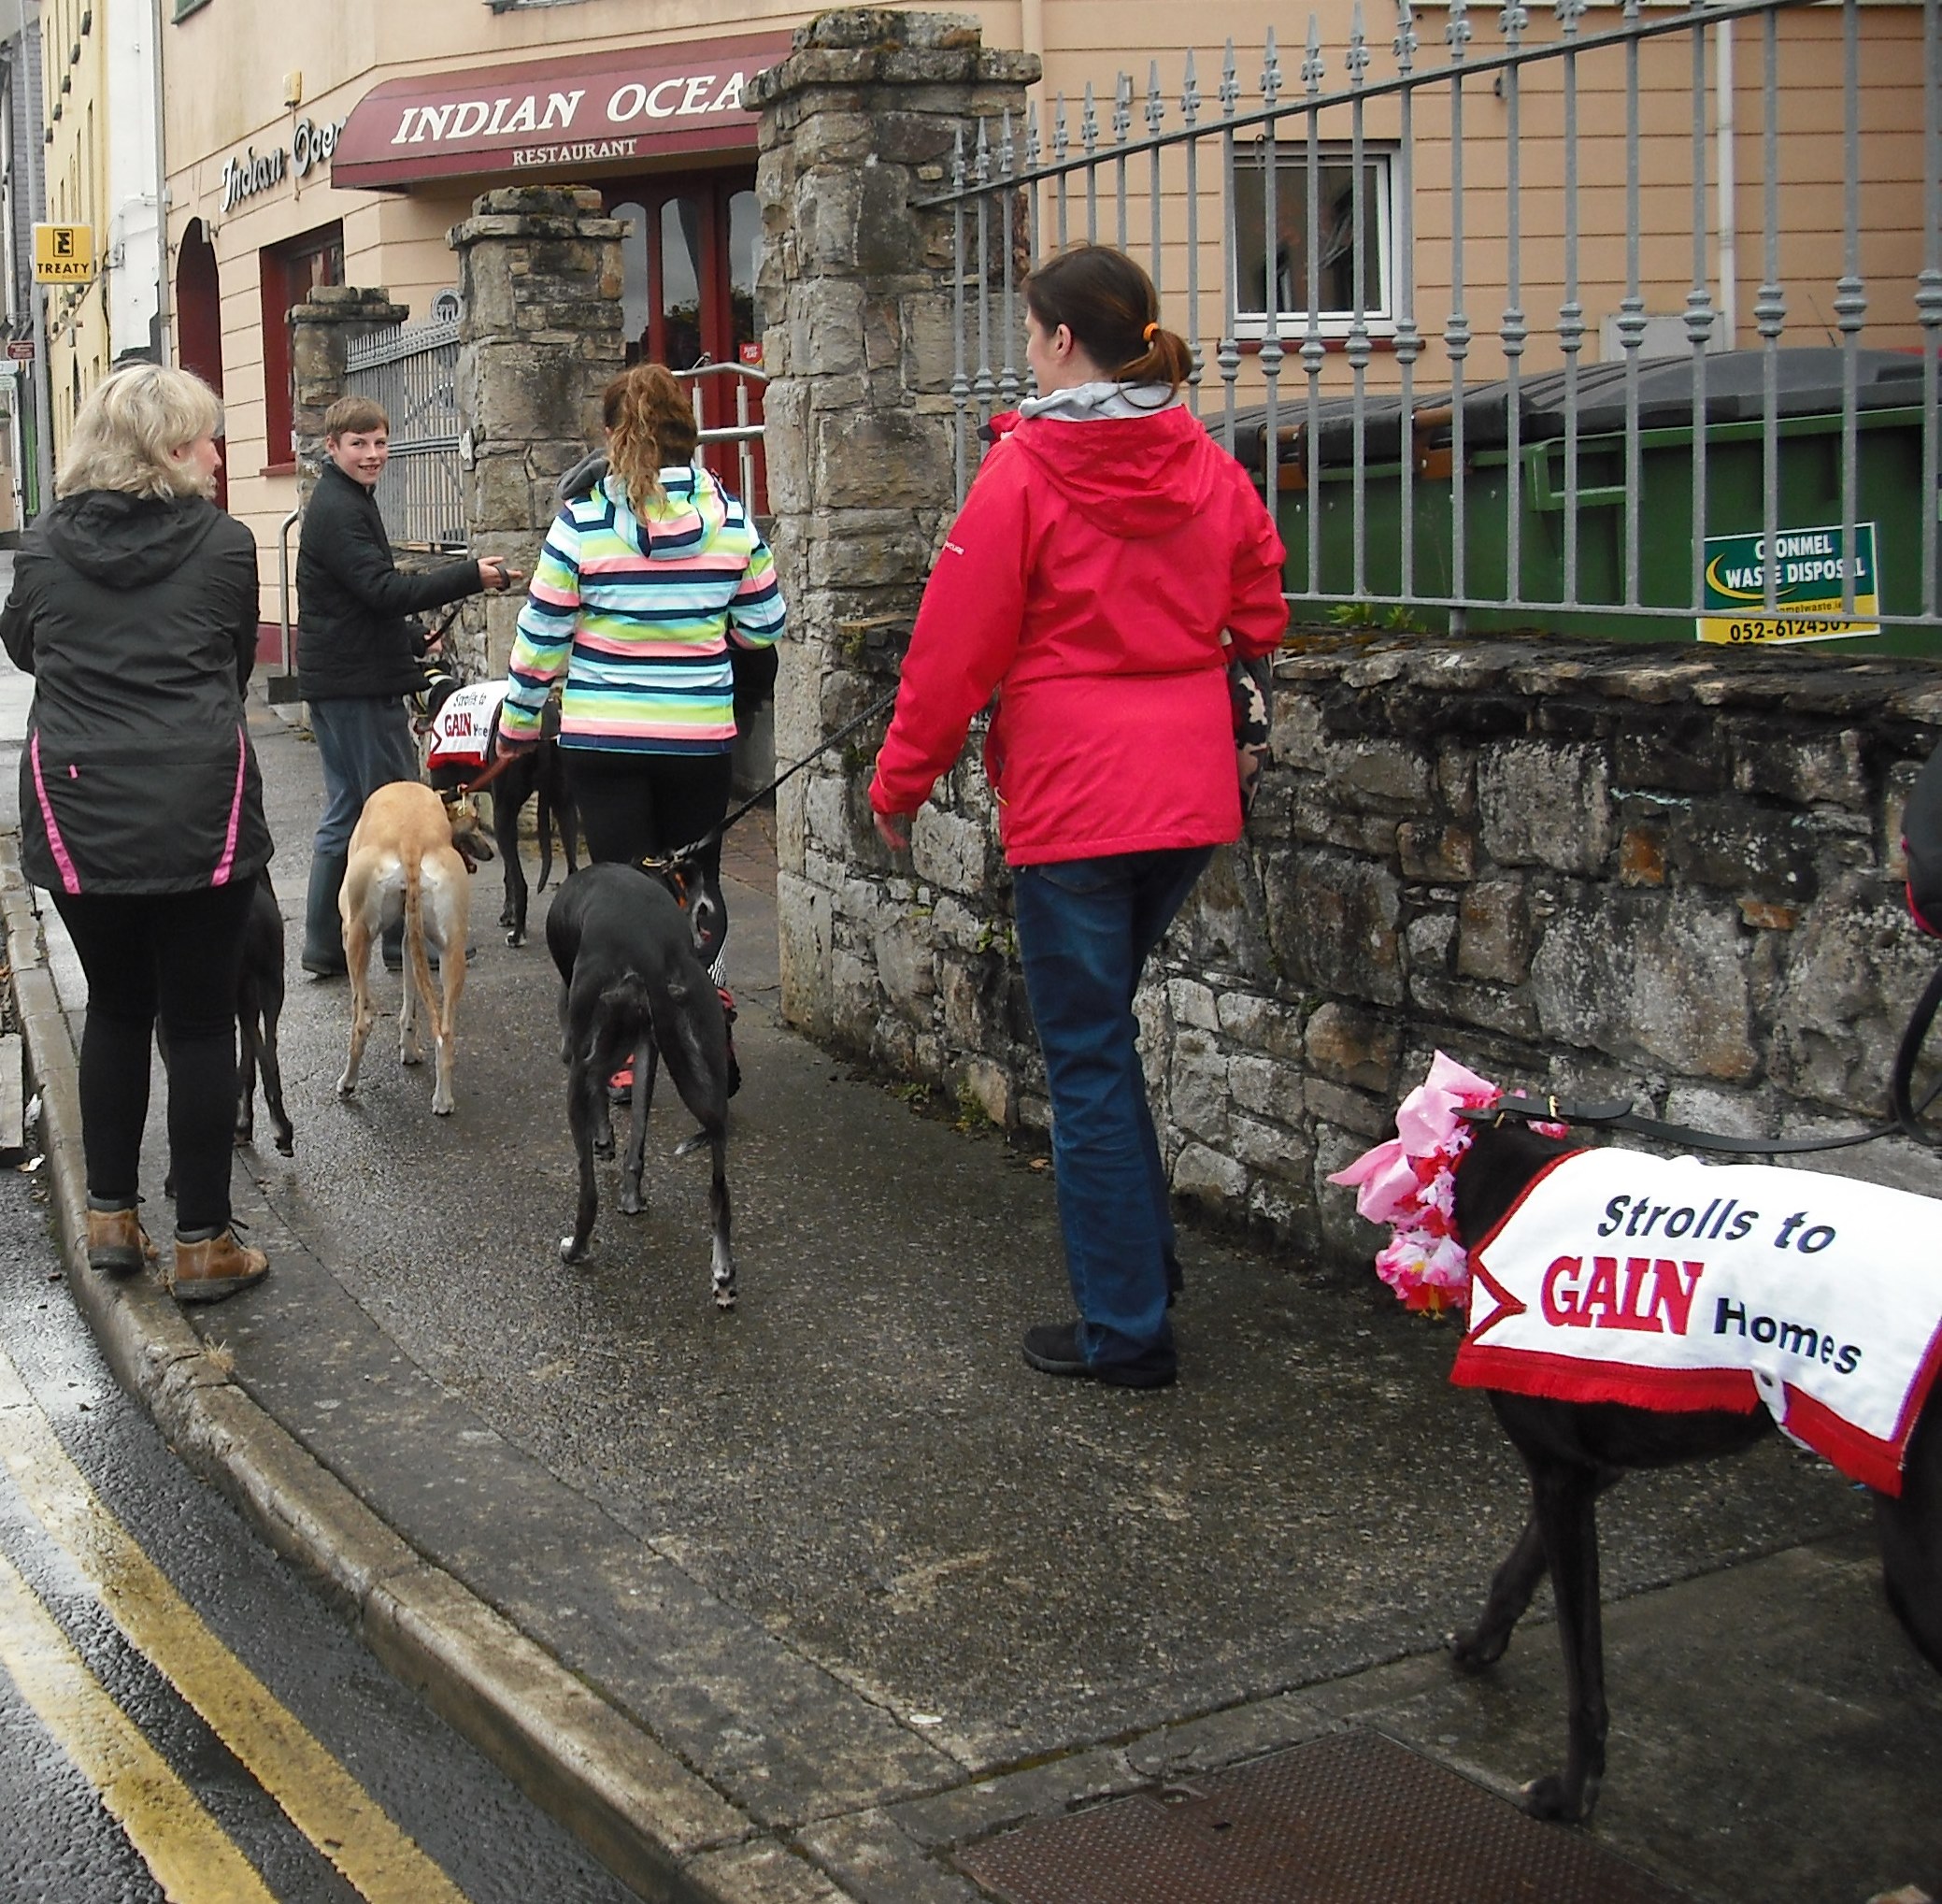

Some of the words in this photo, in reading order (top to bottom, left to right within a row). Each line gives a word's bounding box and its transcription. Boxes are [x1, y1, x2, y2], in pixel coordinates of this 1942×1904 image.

[391, 90, 585, 144] INDIAN
[606, 68, 768, 122] OCEA
[512, 139, 637, 166] RESTAURANT
[220, 146, 284, 212] Indian
[37, 263, 89, 274] TREATY
[1755, 535, 1833, 560] CONMEL
[1725, 565, 1782, 589] WASE
[1787, 558, 1865, 583] DISPOSL
[444, 712, 472, 737] GAIN
[1597, 1195, 1759, 1240] Strolls
[1774, 1211, 1836, 1253] to
[1541, 1255, 1705, 1336] GAIN
[1714, 1298, 1863, 1374] Homes
